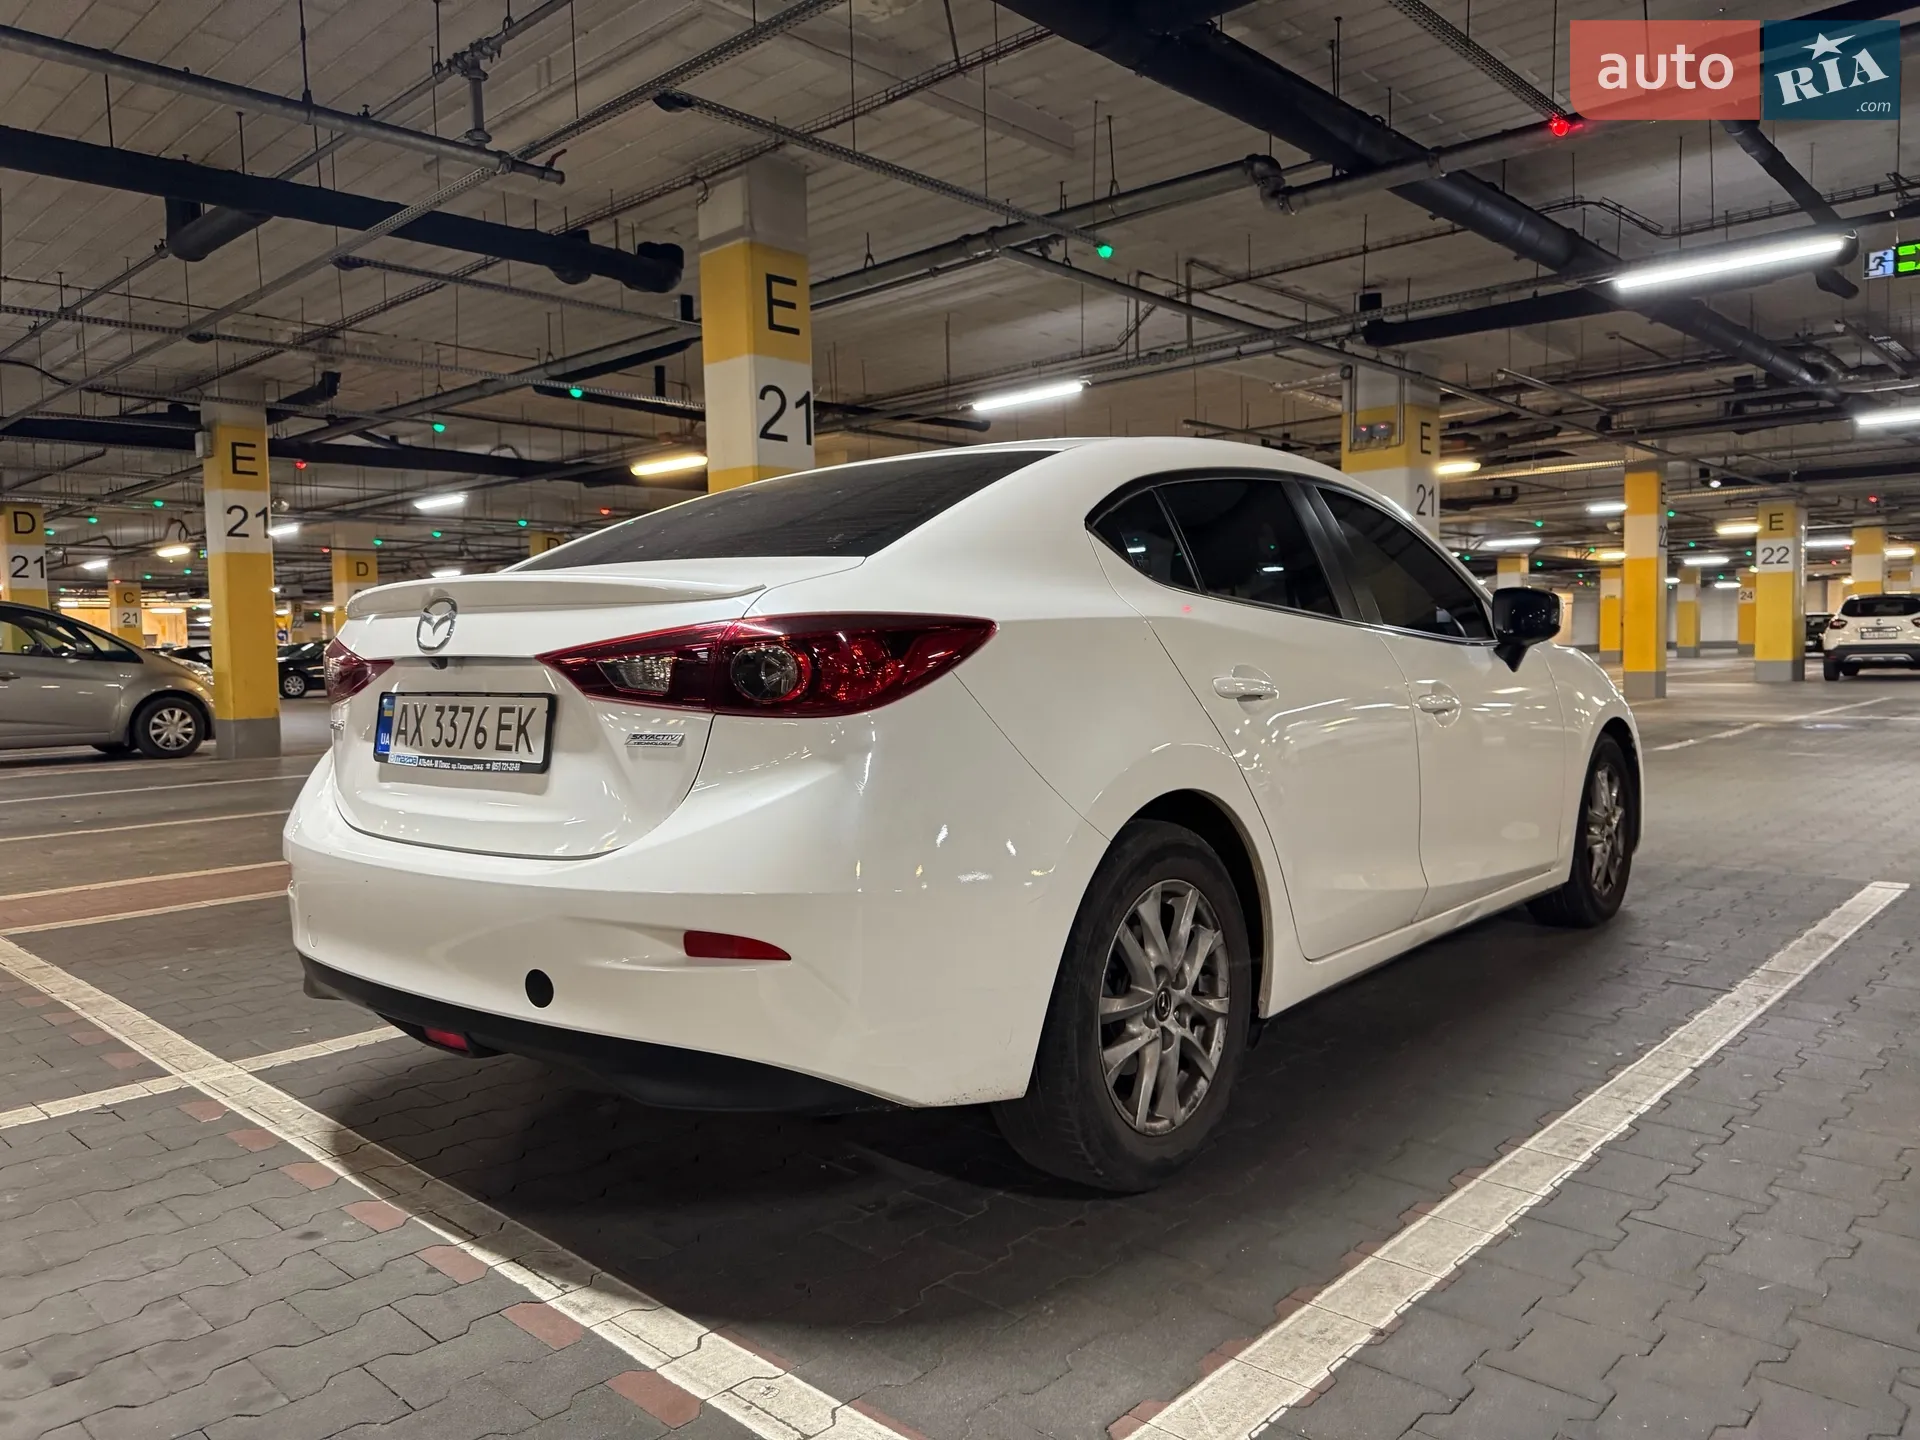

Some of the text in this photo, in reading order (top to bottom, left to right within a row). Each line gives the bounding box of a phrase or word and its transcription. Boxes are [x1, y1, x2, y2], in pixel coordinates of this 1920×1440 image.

[765, 272, 801, 336] E
[758, 384, 812, 446] 21
[1420, 421, 1432, 455] E
[231, 441, 259, 476] E
[1416, 483, 1435, 518] 21
[13, 510, 36, 534] D
[226, 504, 269, 539] 21
[1768, 512, 1785, 532] E
[11, 554, 45, 579] 21
[1761, 546, 1790, 565] 22
[356, 561, 369, 577] D
[123, 591, 135, 604] C
[1740, 590, 1753, 601] 24
[122, 611, 138, 624] 21
[380, 732, 390, 745] UA
[394, 702, 537, 753] AX 3376 EK
